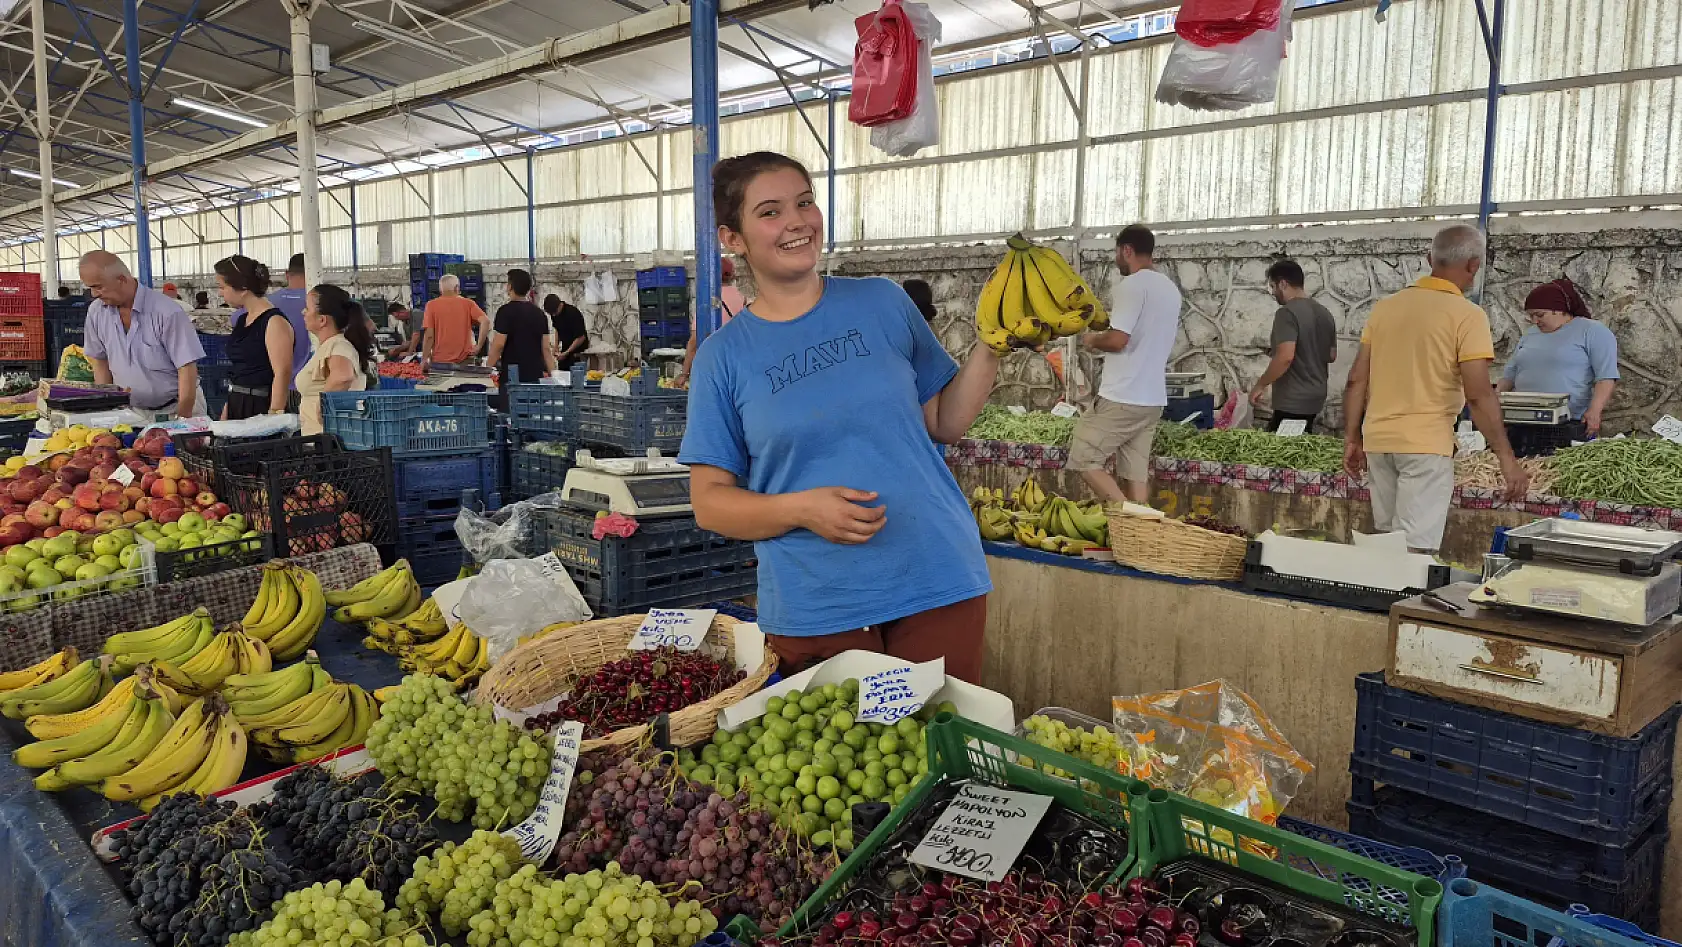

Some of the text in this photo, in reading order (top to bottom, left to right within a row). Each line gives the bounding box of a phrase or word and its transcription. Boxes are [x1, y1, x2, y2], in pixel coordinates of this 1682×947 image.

[764, 328, 871, 395] MAVİ
[417, 419, 458, 434] AKA-76
[958, 786, 1012, 805] SWEET
